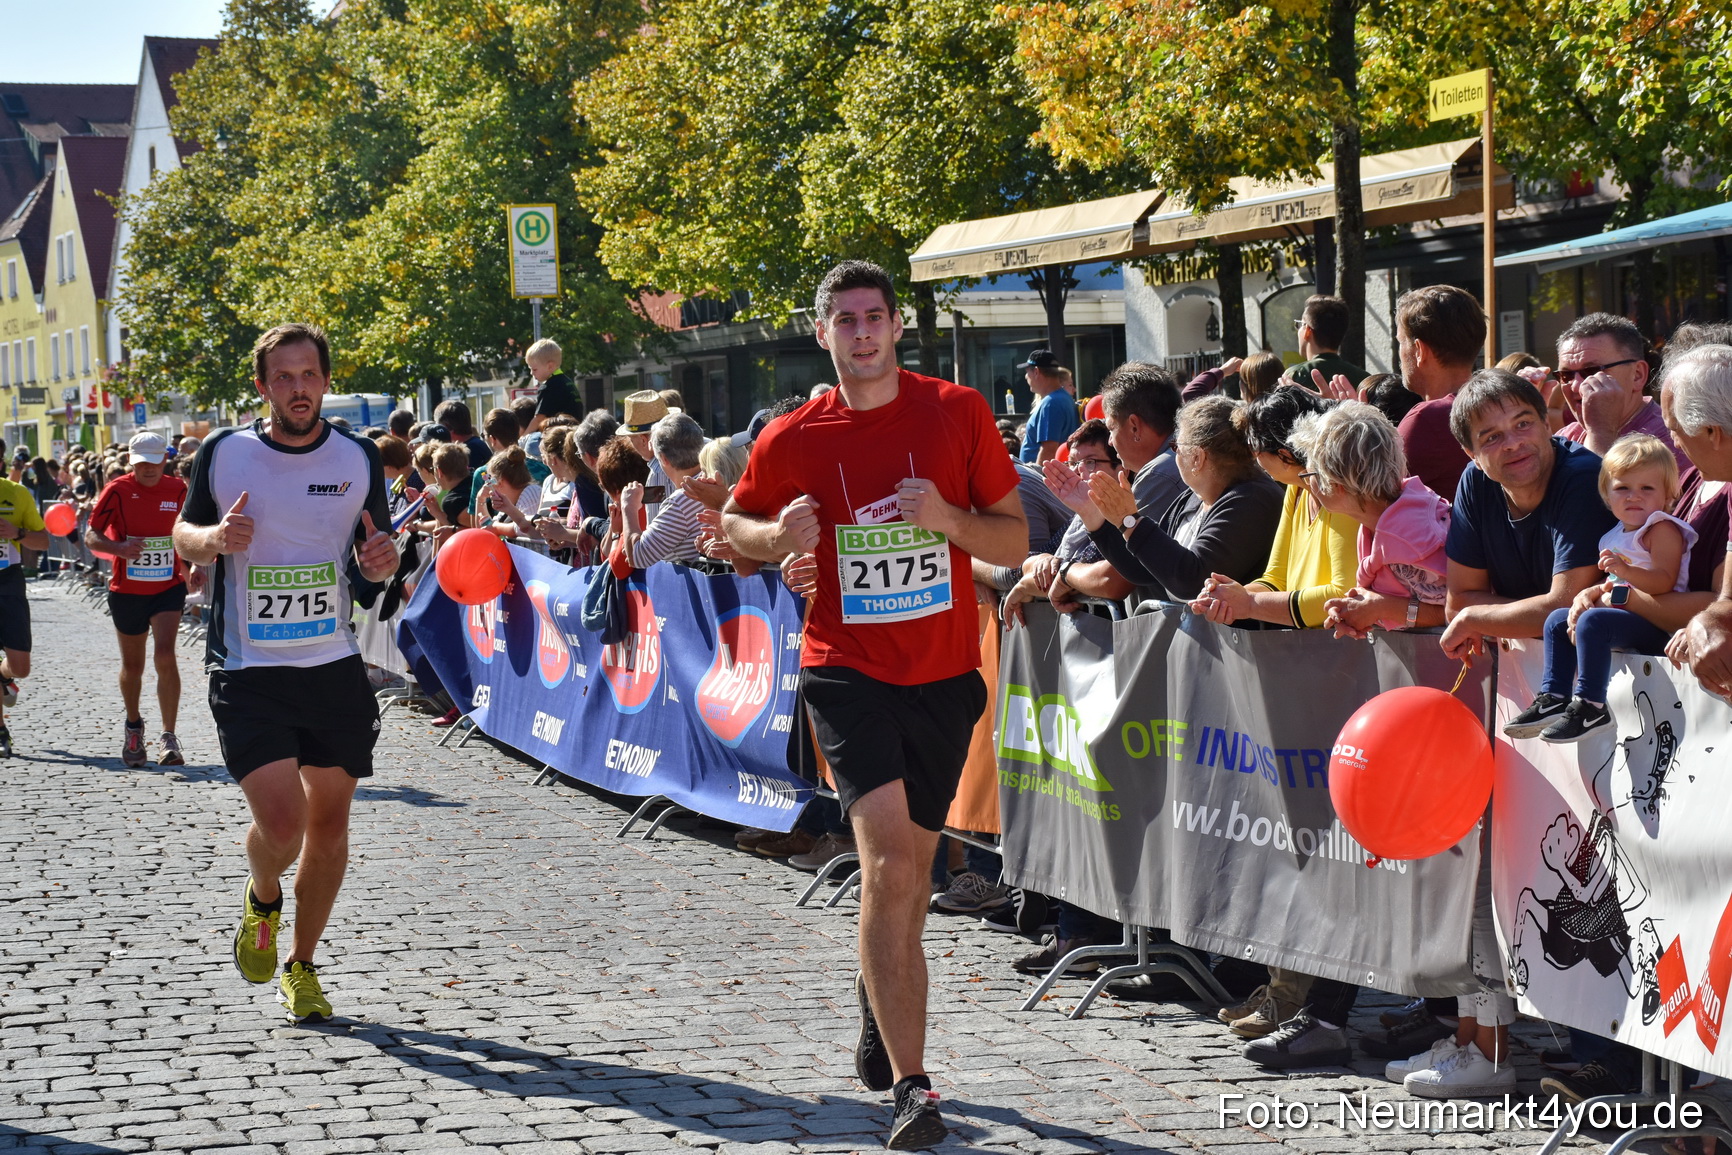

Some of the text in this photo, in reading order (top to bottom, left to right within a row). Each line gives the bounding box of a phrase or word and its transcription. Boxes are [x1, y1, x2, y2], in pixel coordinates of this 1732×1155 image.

[1440, 85, 1483, 107] Toiletten
[524, 219, 541, 239] H
[160, 501, 178, 509] JURA
[872, 501, 897, 519] DEHN
[844, 525, 939, 552] BOCK
[133, 569, 168, 577] HERBERT
[254, 566, 331, 587] BOCK
[850, 552, 938, 589] 2175
[258, 591, 327, 619] 2715
[862, 591, 933, 612] THOMAS
[263, 624, 312, 638] Fabian
[704, 641, 770, 716] Hervis
[1195, 726, 1330, 789] INDUSTR
[1338, 757, 1366, 770] energie
[1657, 982, 1688, 1022] Braun
